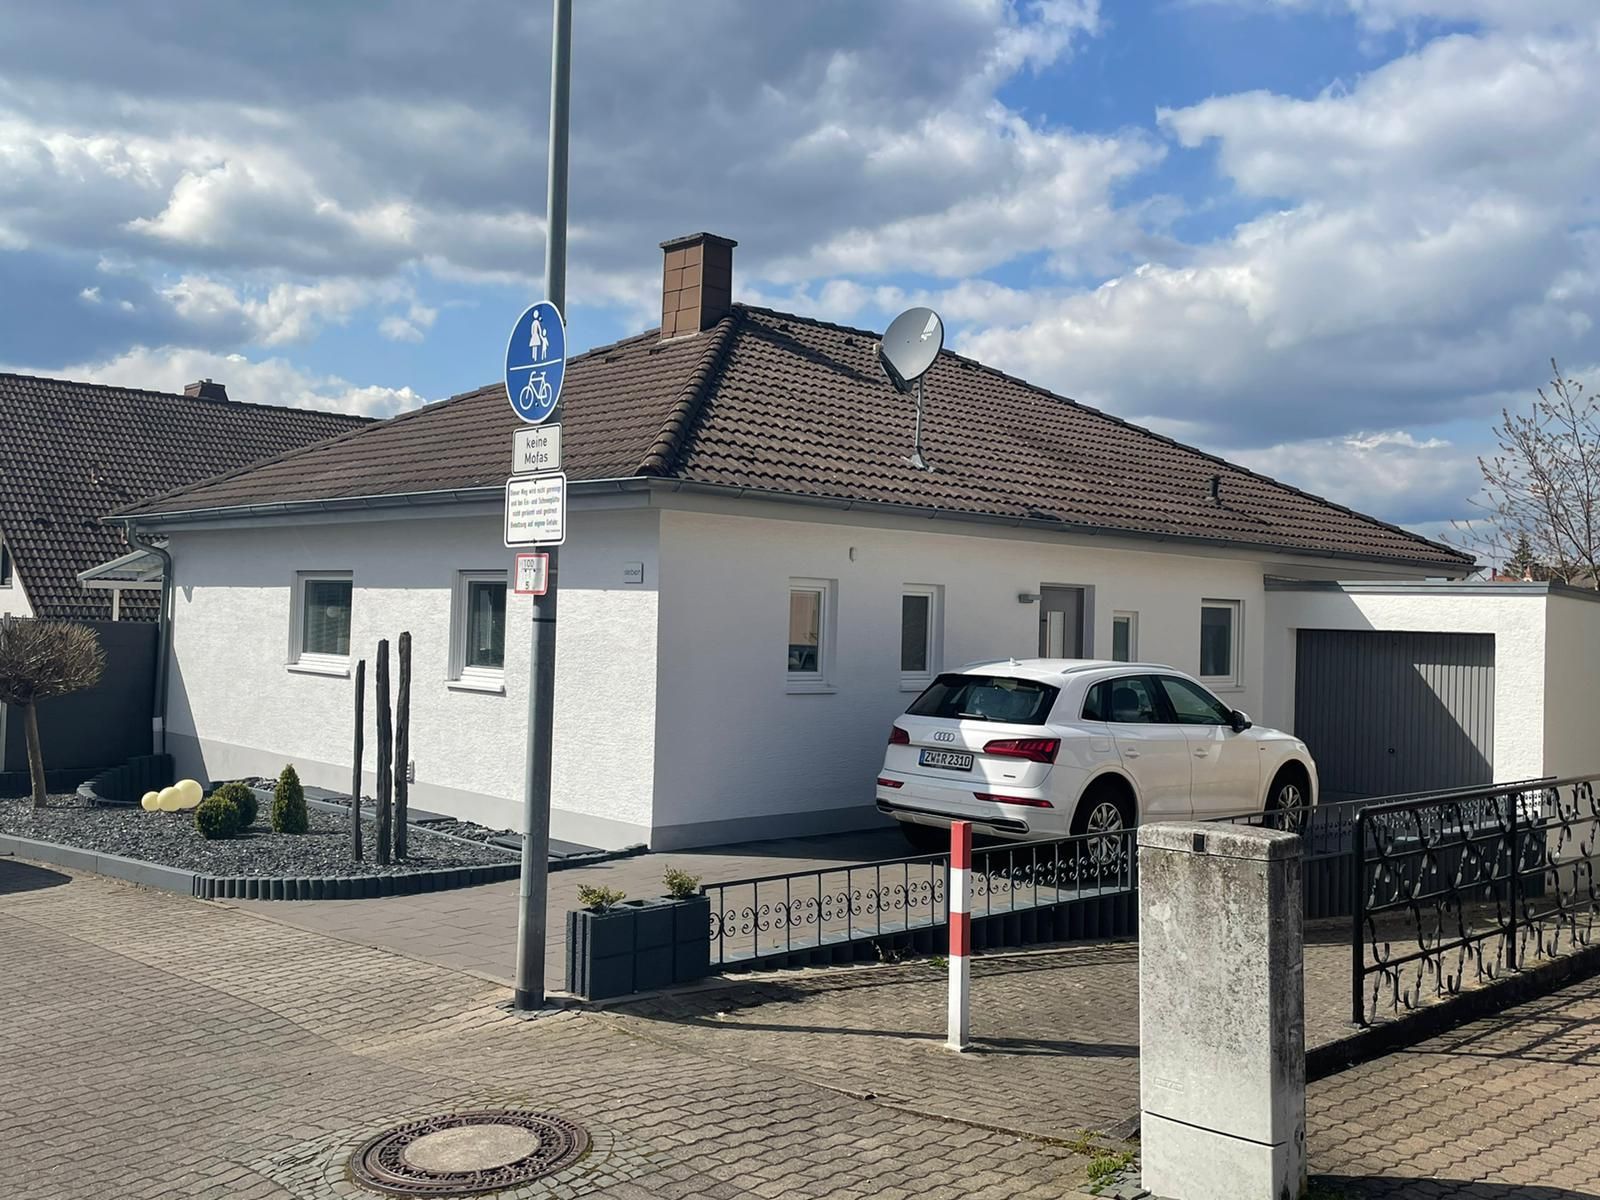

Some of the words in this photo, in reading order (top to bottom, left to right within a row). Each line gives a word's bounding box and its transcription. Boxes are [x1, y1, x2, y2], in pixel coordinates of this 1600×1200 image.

[526, 437, 548, 449] keine
[524, 451, 549, 464] Mofas
[925, 751, 936, 763] ZW
[940, 753, 947, 765] R
[948, 754, 970, 767] 2310
